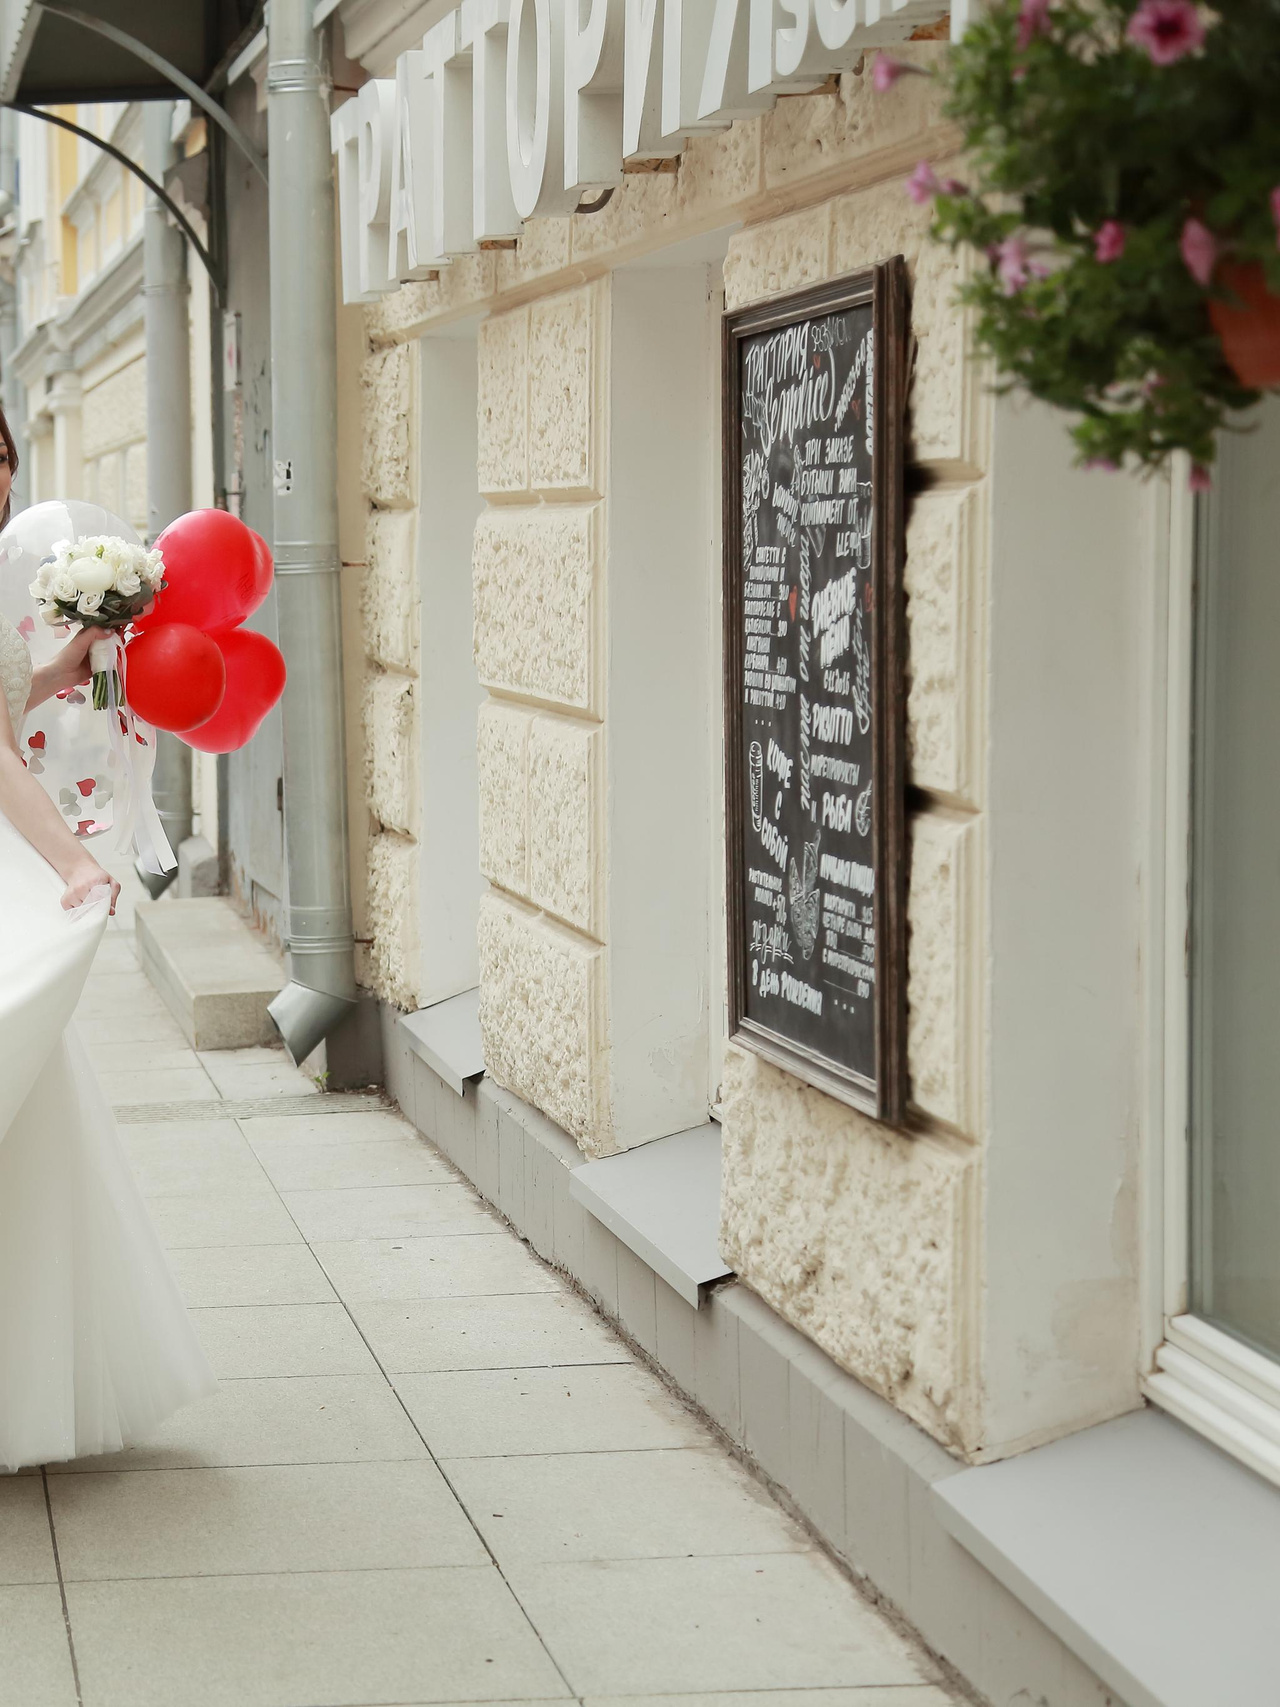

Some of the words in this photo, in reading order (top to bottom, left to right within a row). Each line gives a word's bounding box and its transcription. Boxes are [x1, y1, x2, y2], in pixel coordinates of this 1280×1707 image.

[746, 321, 810, 397] ТРАТТОРИЯ
[805, 438, 821, 466] ПРИ
[825, 435, 854, 465] ЗАКАЗЕ
[800, 469, 835, 496] БУТЫЛКИ
[838, 467, 858, 493] ВИНА
[800, 498, 845, 526] КОМПЛИМЕНТ
[847, 498, 859, 524] ОТ
[811, 567, 857, 639] ДНЕВНОЕ
[820, 614, 850, 670] МЕНЮ
[812, 703, 853, 746] РИЗОТТО
[767, 738, 794, 789] КОФЕ
[775, 791, 783, 820] С
[822, 791, 853, 833] РЫБА
[761, 816, 789, 873] СОБОЙ
